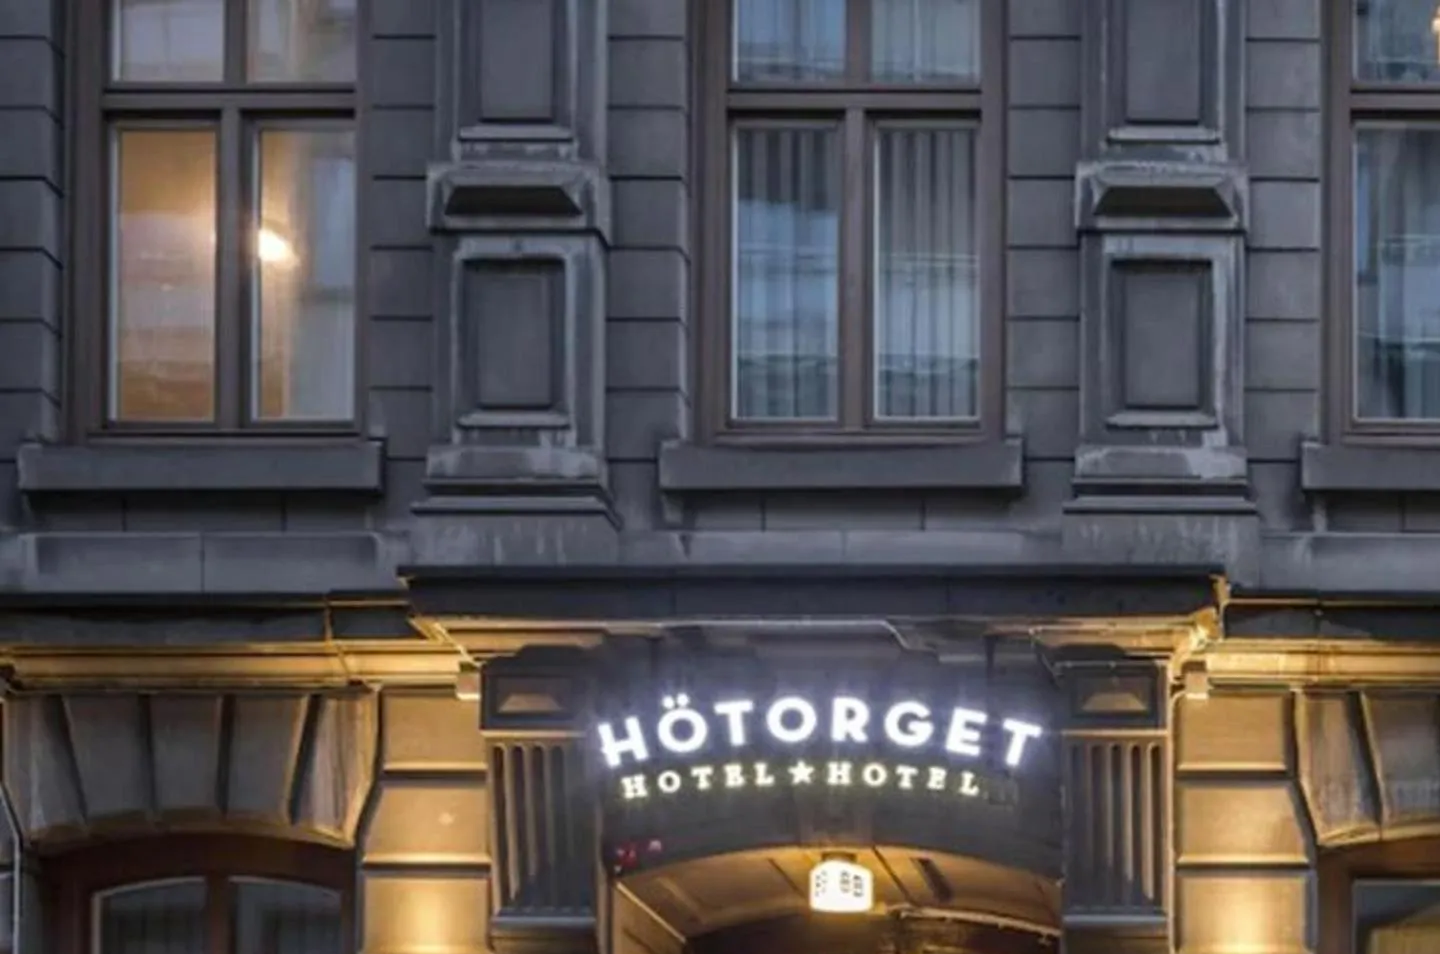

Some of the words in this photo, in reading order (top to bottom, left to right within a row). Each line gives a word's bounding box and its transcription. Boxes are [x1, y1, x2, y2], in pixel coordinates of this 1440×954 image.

[598, 693, 1042, 767] HÖTORGET
[621, 761, 775, 799] HOTEL
[827, 761, 980, 796] HOTEL
